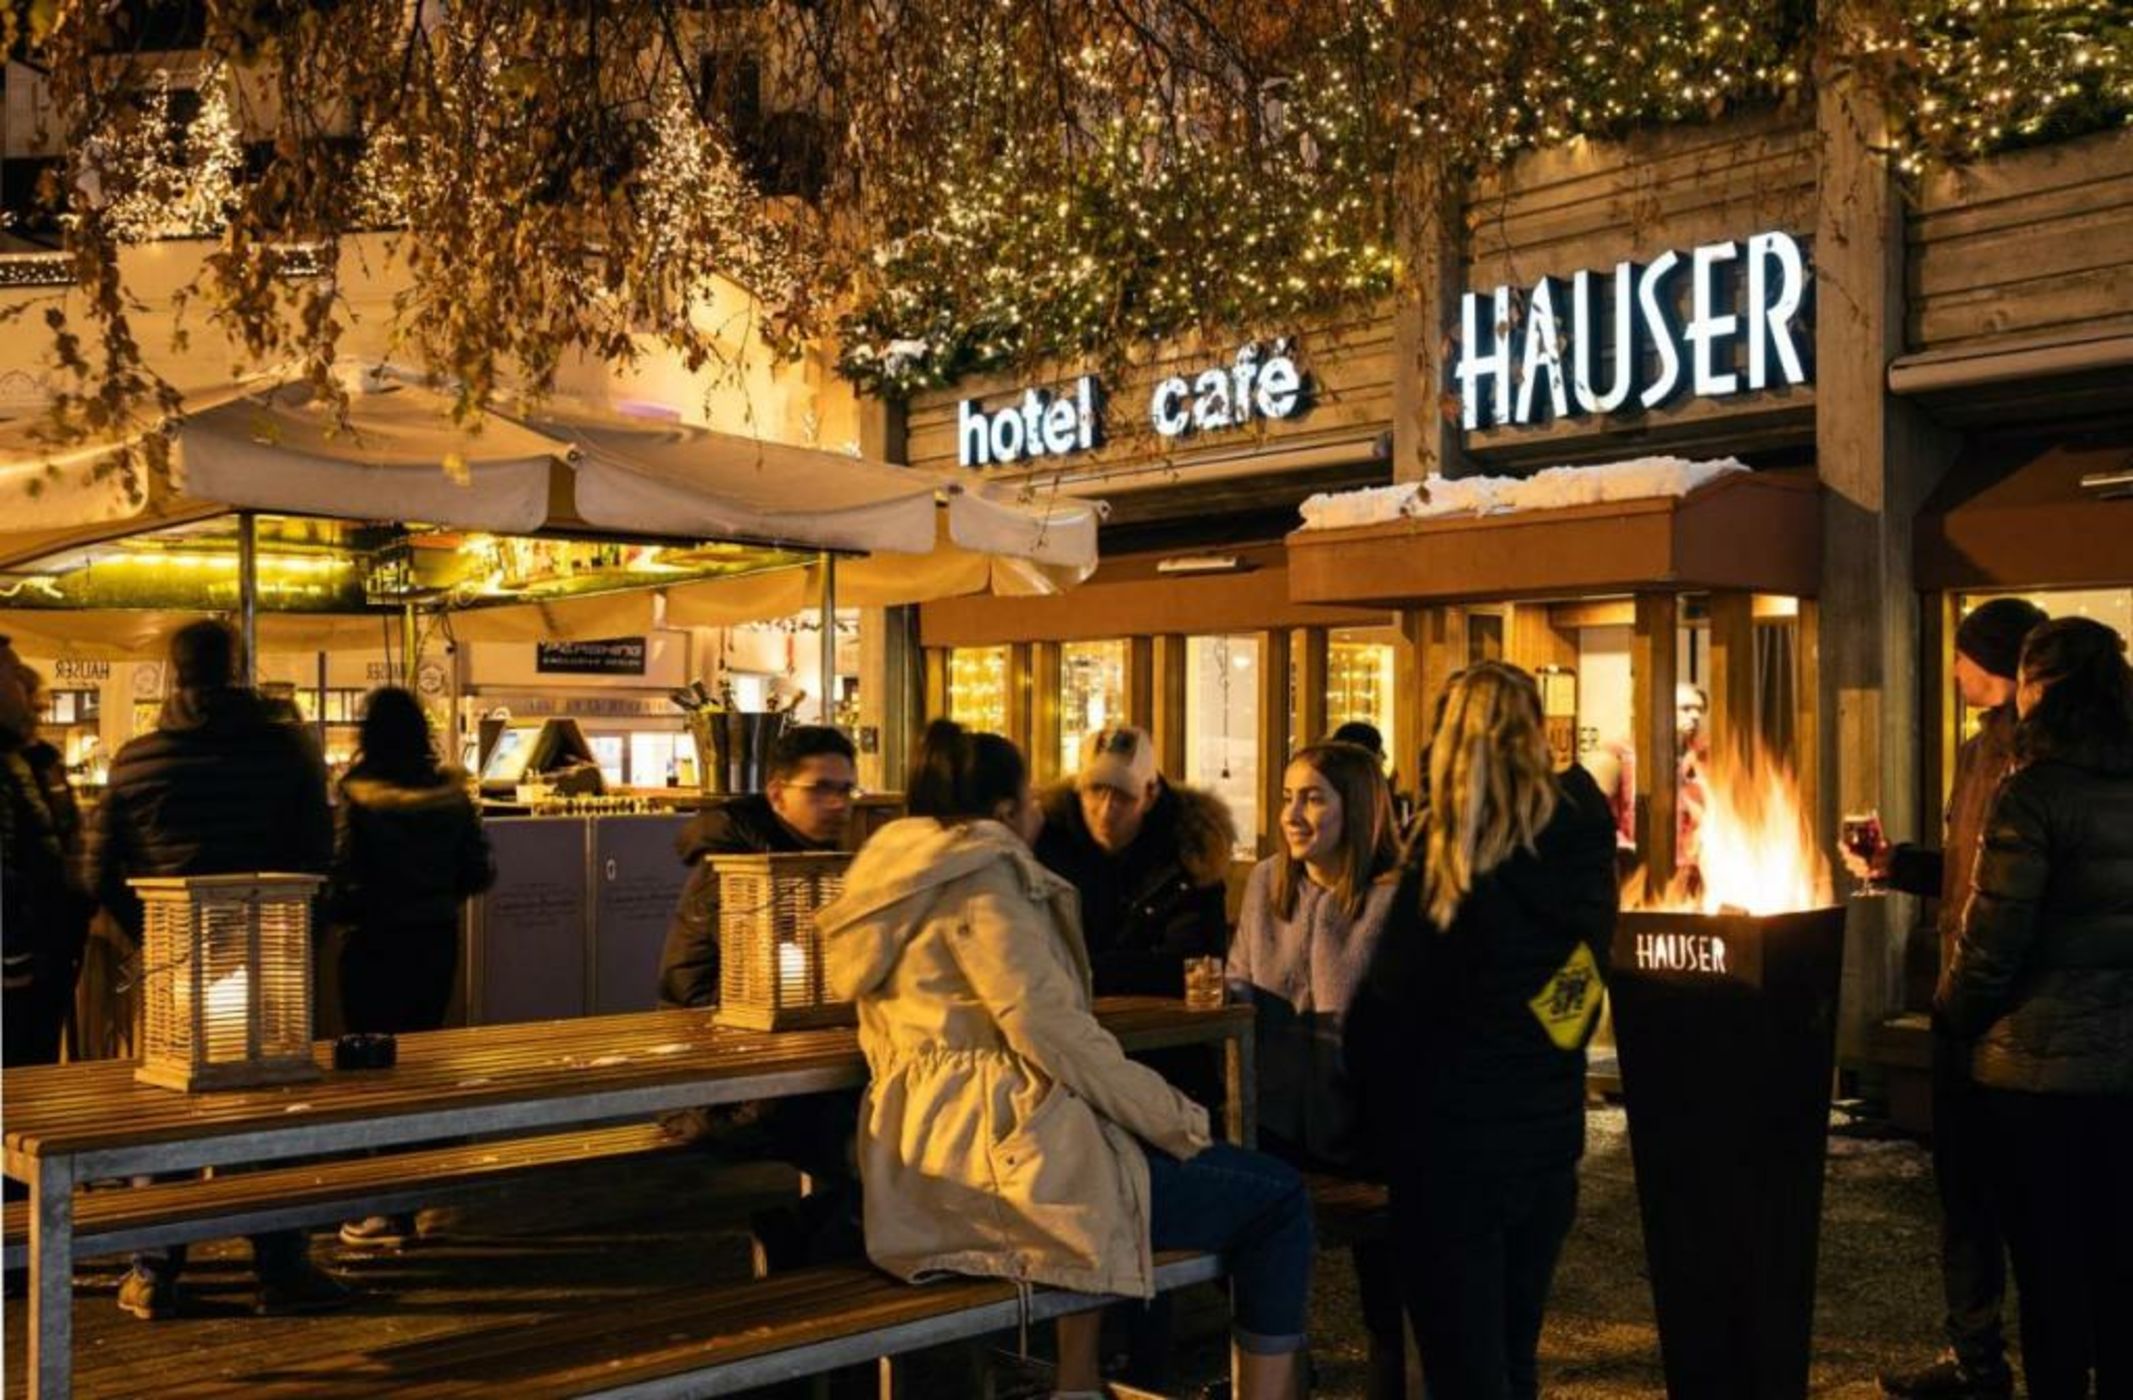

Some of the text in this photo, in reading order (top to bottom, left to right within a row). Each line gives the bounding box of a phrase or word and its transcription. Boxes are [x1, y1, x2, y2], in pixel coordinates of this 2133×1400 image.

[958, 231, 1805, 467] hotel café HAUSER
[1635, 933, 1727, 974] HAUSER
